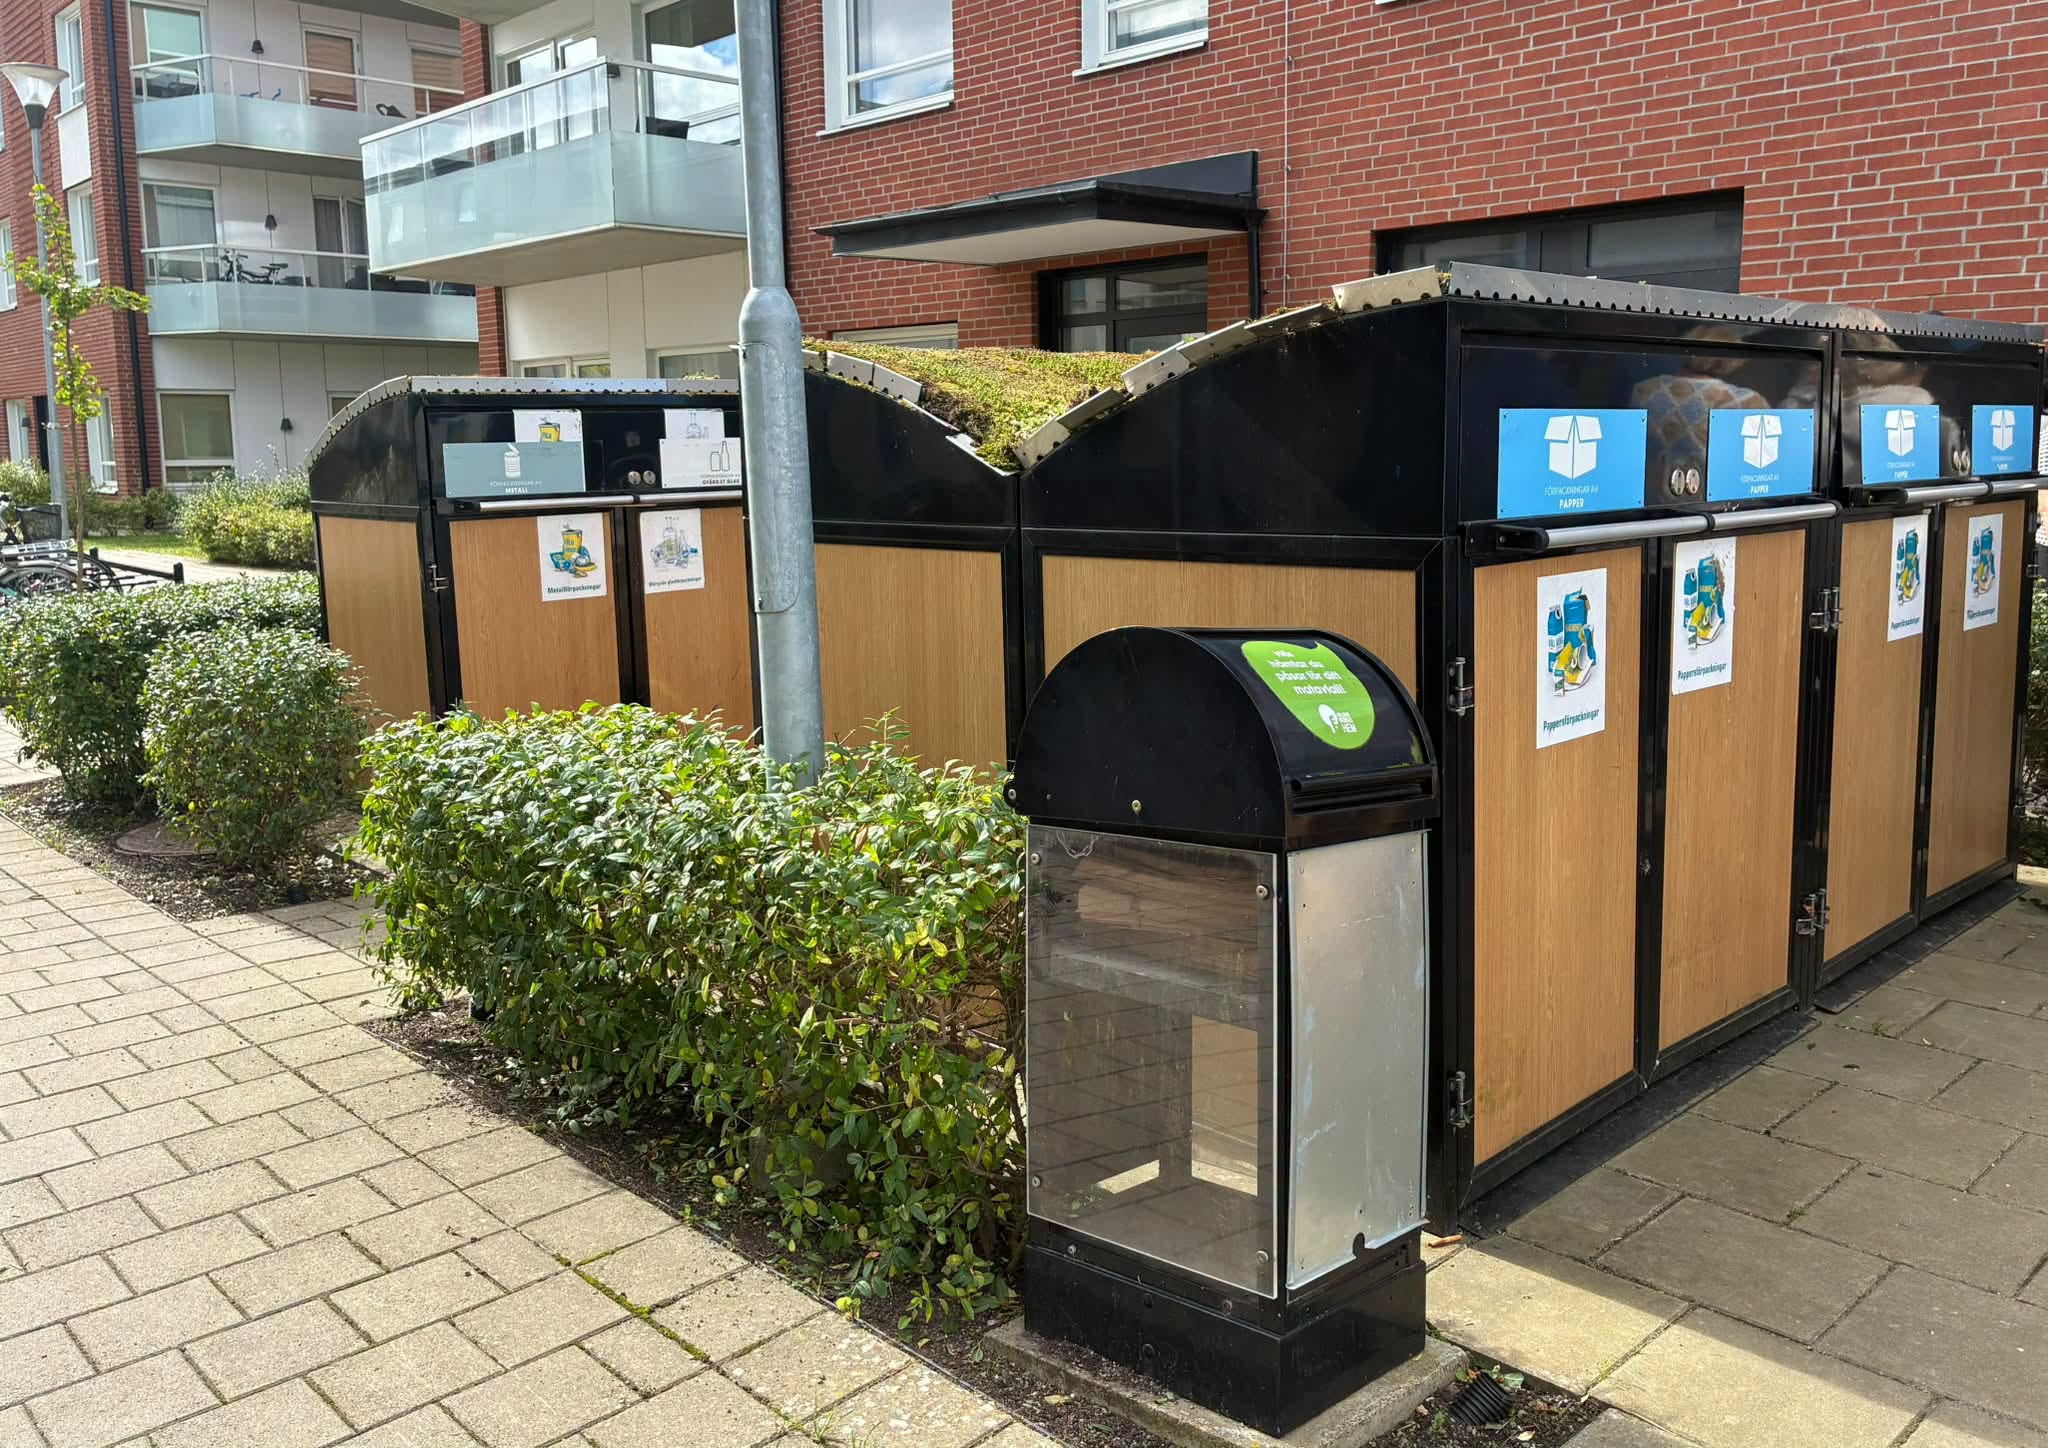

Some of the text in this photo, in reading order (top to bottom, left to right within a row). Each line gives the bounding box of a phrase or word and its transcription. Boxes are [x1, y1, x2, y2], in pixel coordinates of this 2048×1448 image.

[505, 487, 528, 495] METALL
[1750, 485, 1769, 495] PAPPER
[1559, 498, 1584, 509] PAPPER
[547, 583, 602, 595] Metallförpackningar
[1275, 670, 1342, 683] påsar för ditt
[1677, 662, 1727, 681] Pappersförpackningar
[1293, 684, 1347, 695] matavfall!
[1543, 708, 1600, 733] Pappersförpackningar
